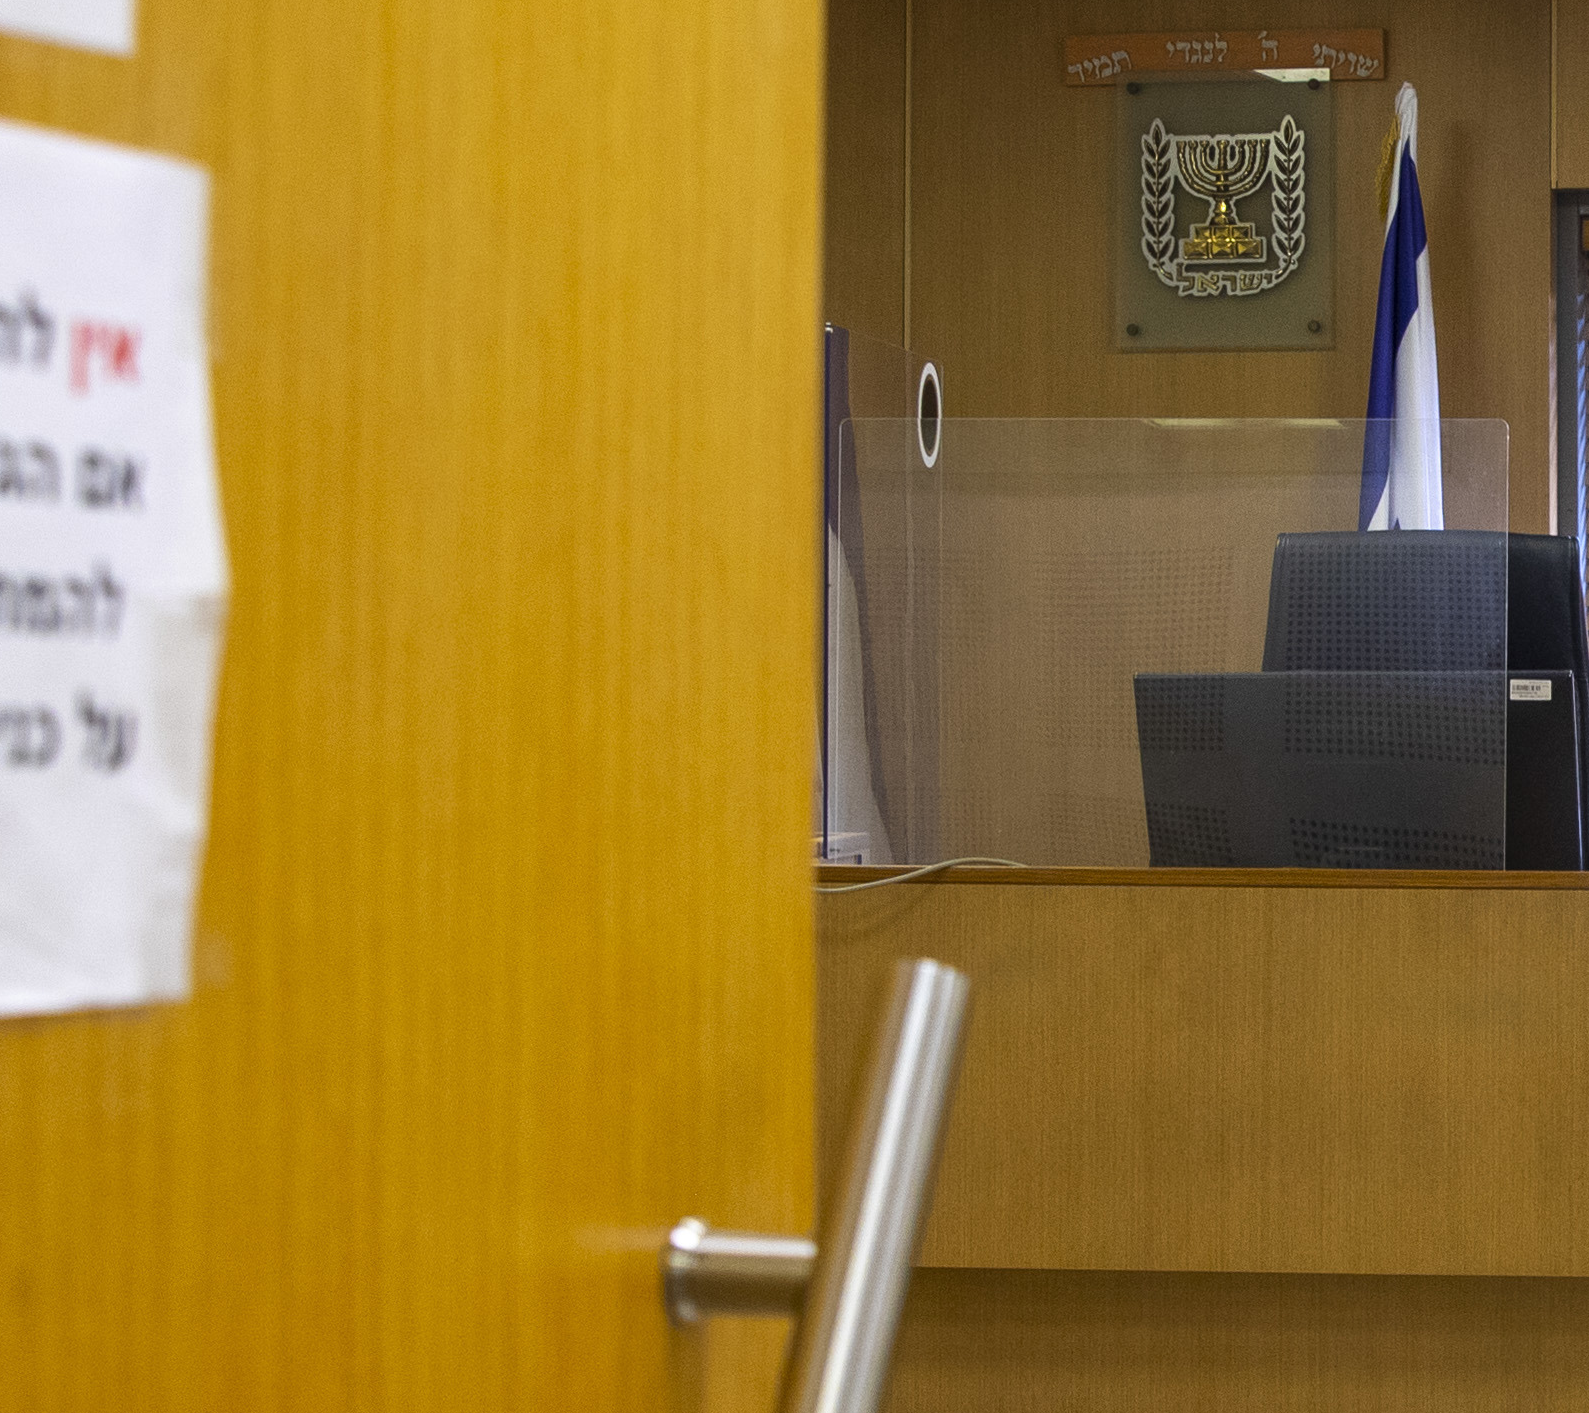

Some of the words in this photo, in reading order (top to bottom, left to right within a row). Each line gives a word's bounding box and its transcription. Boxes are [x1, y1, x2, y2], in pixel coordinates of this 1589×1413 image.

[1166, 32, 1228, 64] לנגדי
[1313, 42, 1379, 77] שויתי
[1067, 49, 1132, 83] תמיד
[1176, 262, 1273, 293] ישראל
[70, 318, 139, 395] אין
[77, 445, 141, 508] אם
[74, 692, 136, 775] על
